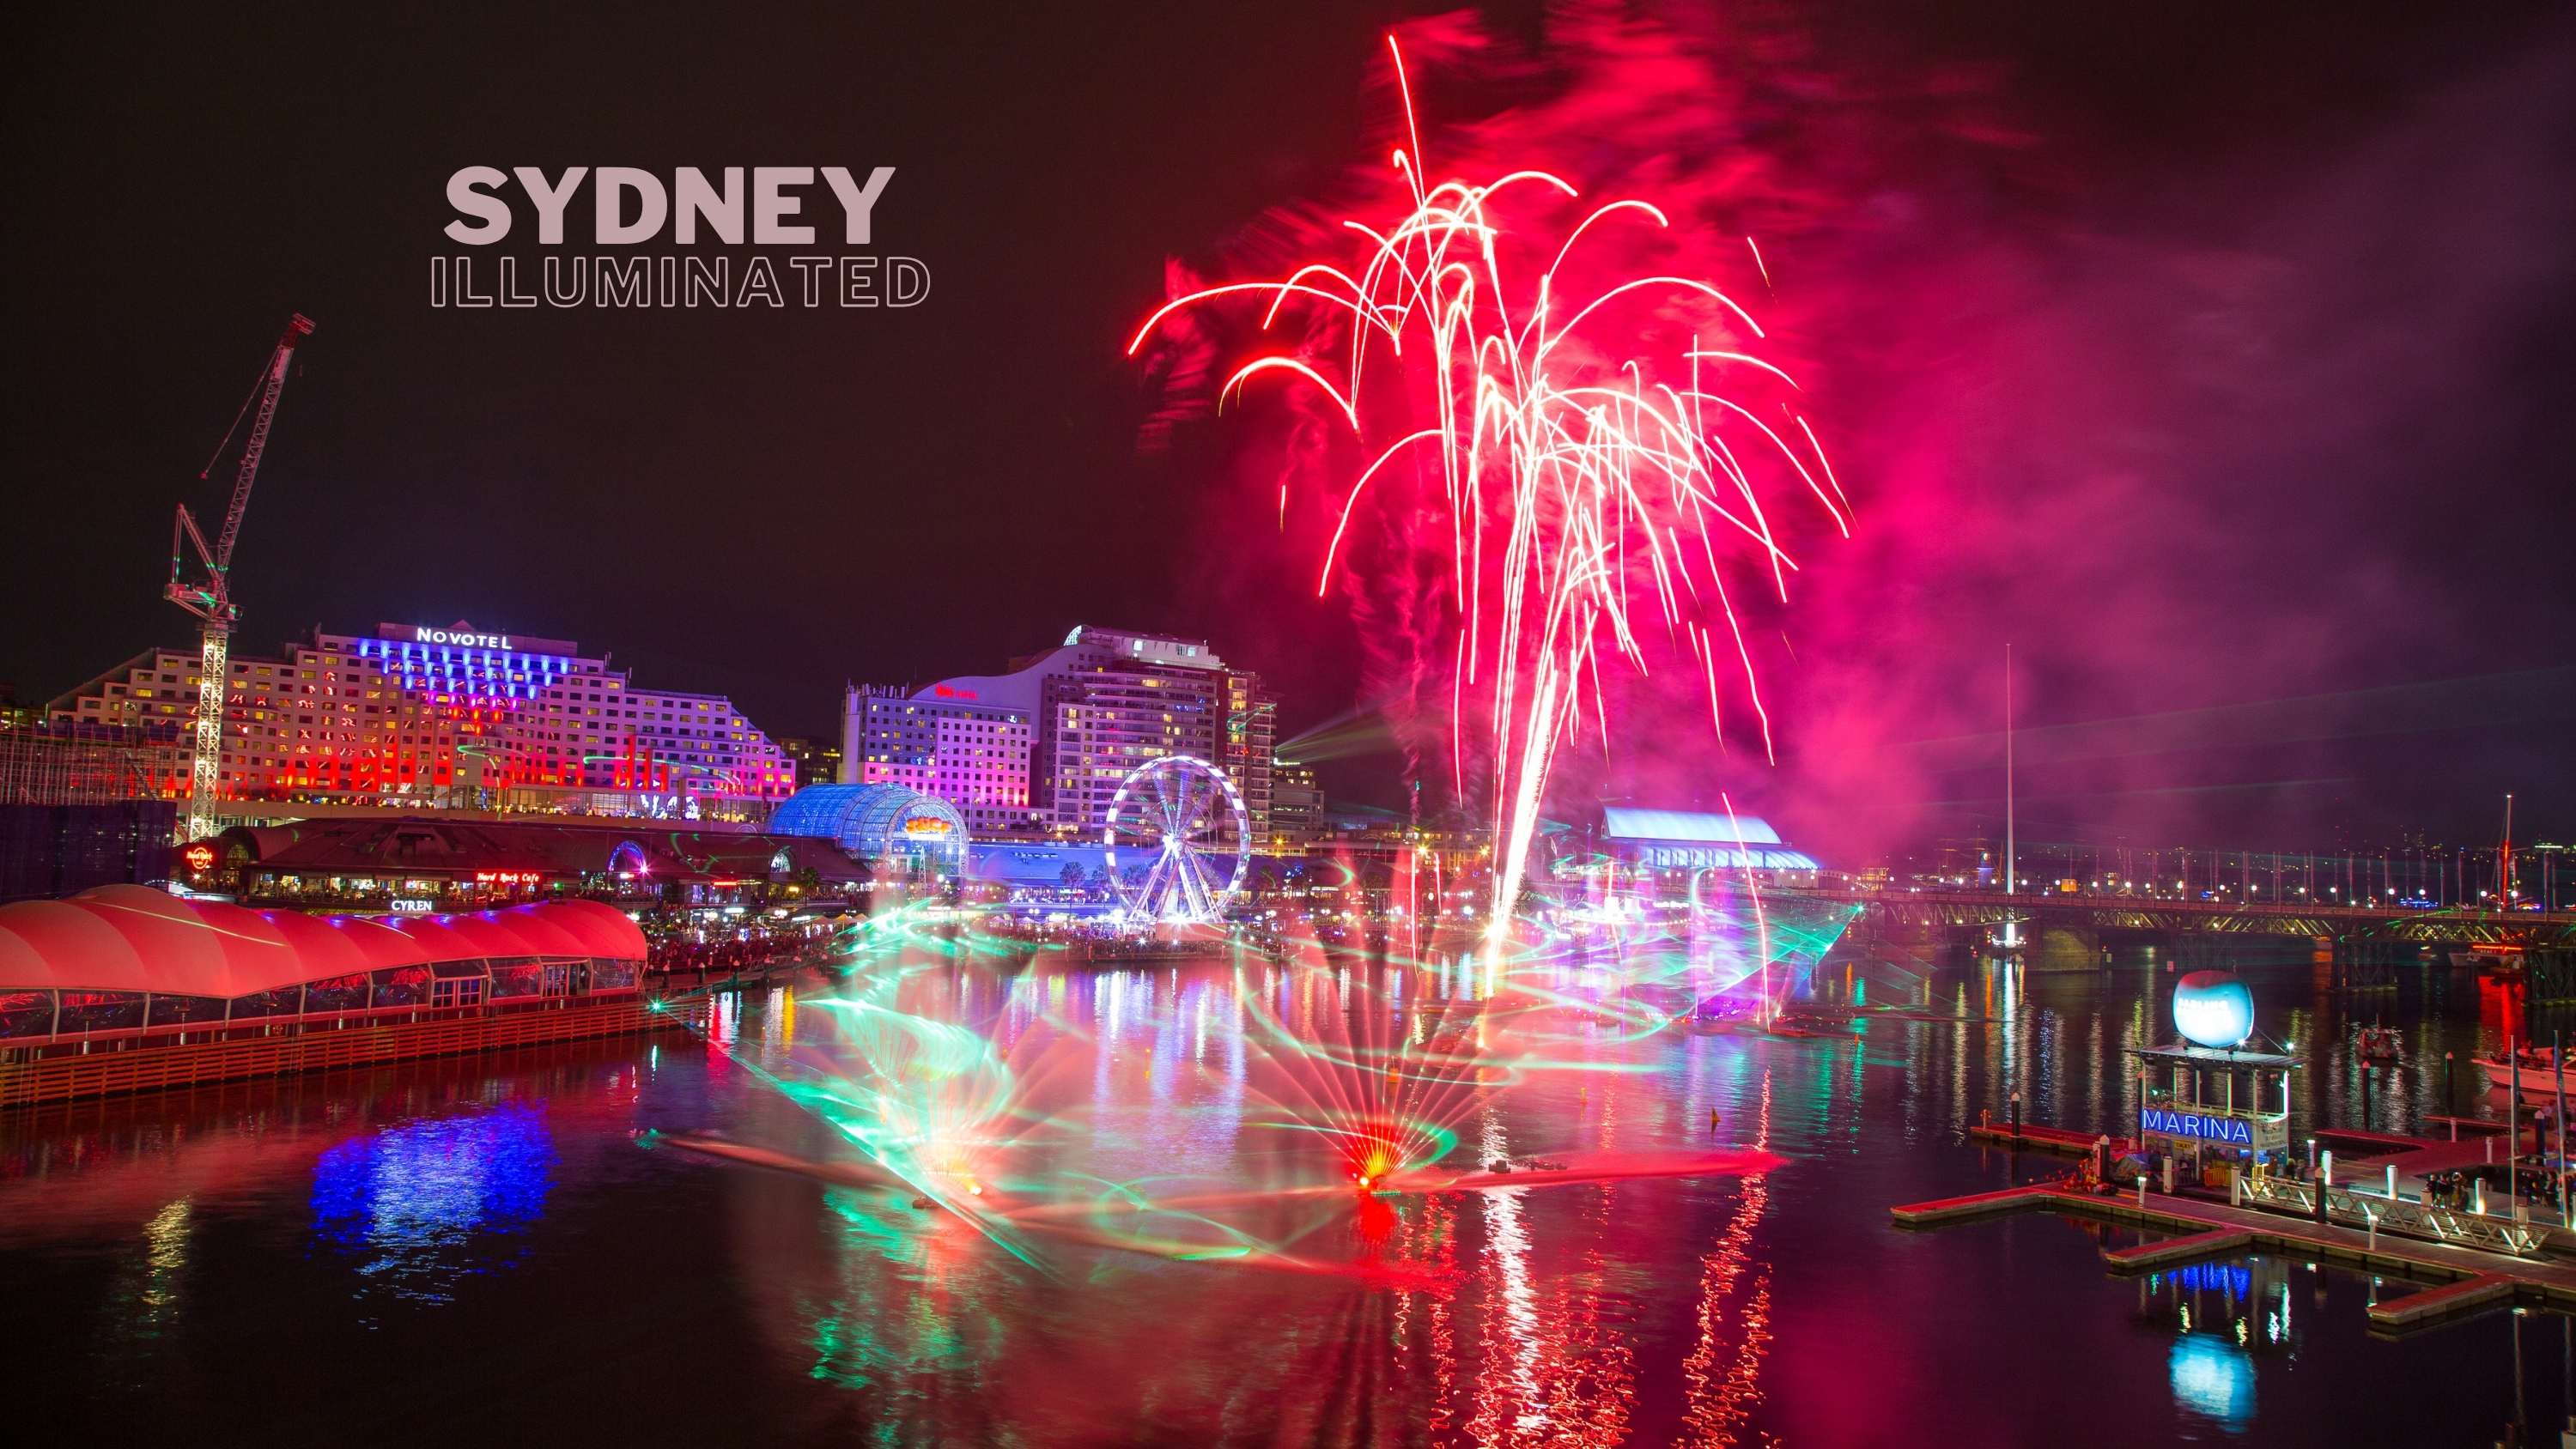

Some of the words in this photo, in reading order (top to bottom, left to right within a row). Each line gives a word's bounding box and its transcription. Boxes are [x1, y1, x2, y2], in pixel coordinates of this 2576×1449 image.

[416, 627, 513, 650] NOVOTEL
[477, 872, 497, 882] Hard
[500, 872, 519, 883] Rock
[521, 873, 539, 883] Cafe
[391, 900, 433, 912] CYREN
[2142, 1109, 2251, 1144] MARINA
